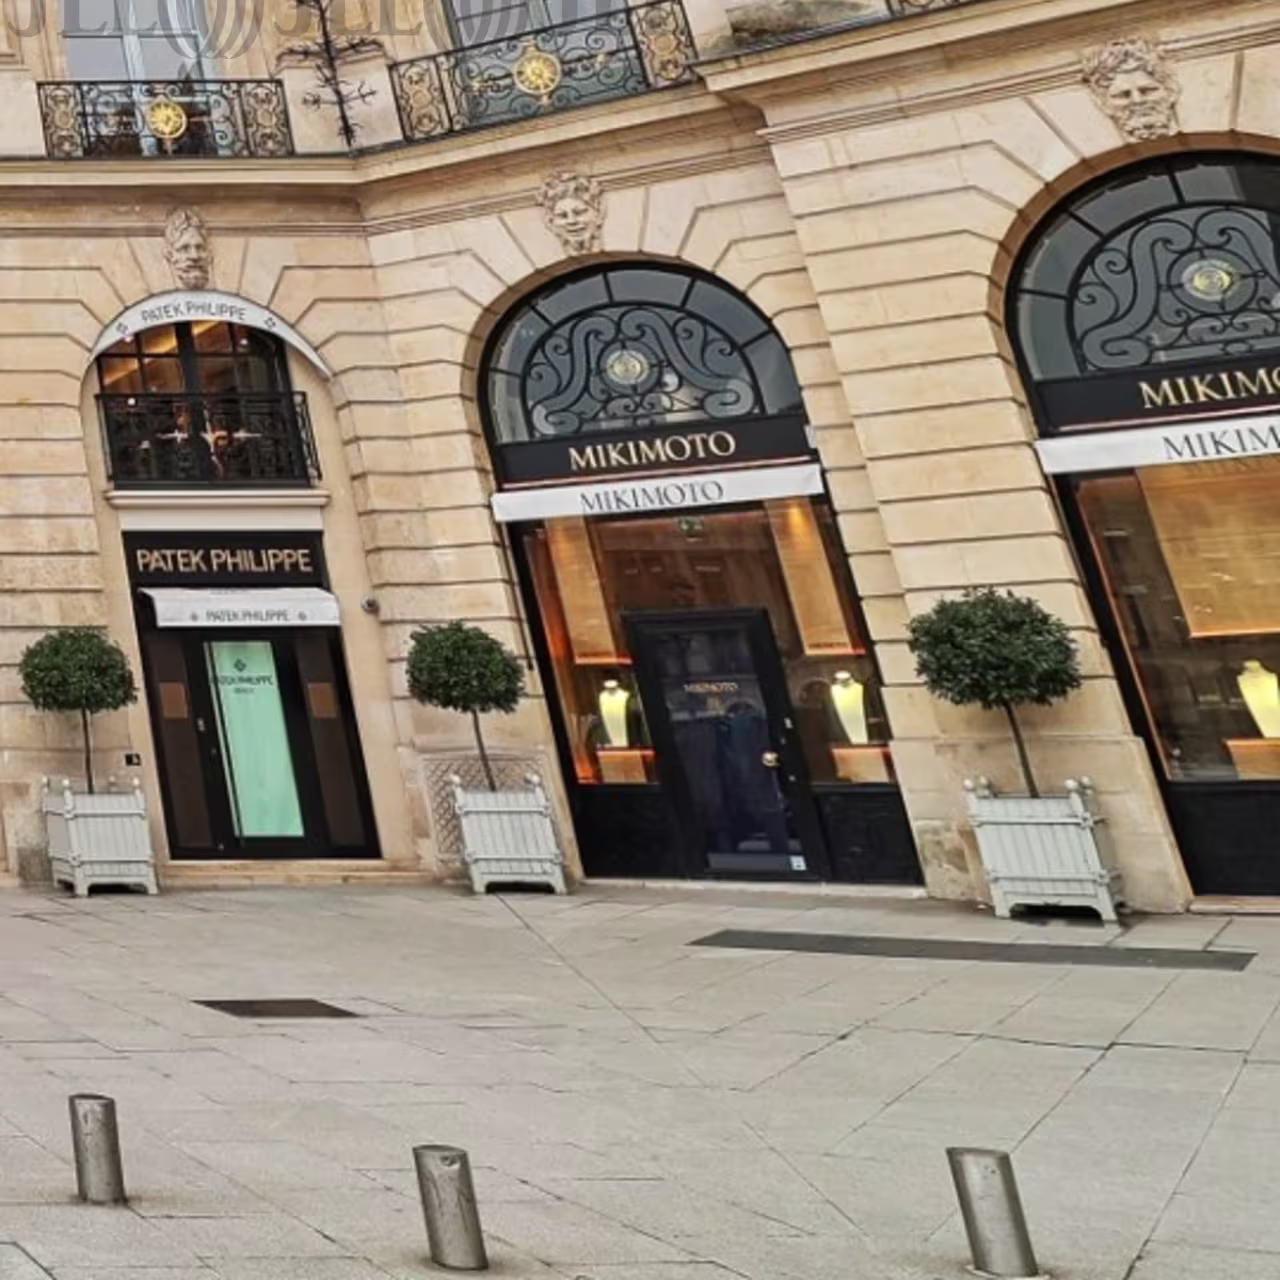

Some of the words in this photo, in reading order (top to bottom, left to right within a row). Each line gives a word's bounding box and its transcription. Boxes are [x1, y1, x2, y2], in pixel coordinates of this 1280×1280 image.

[141, 303, 185, 322] PATEK
[186, 301, 247, 320] PHILIPPE
[1138, 367, 1280, 408] MIKIM
[568, 430, 736, 470] MIKIMOTO
[580, 480, 724, 513] MIKIMOTO
[136, 549, 208, 572] PATEK
[210, 549, 314, 572] PHILIPPE
